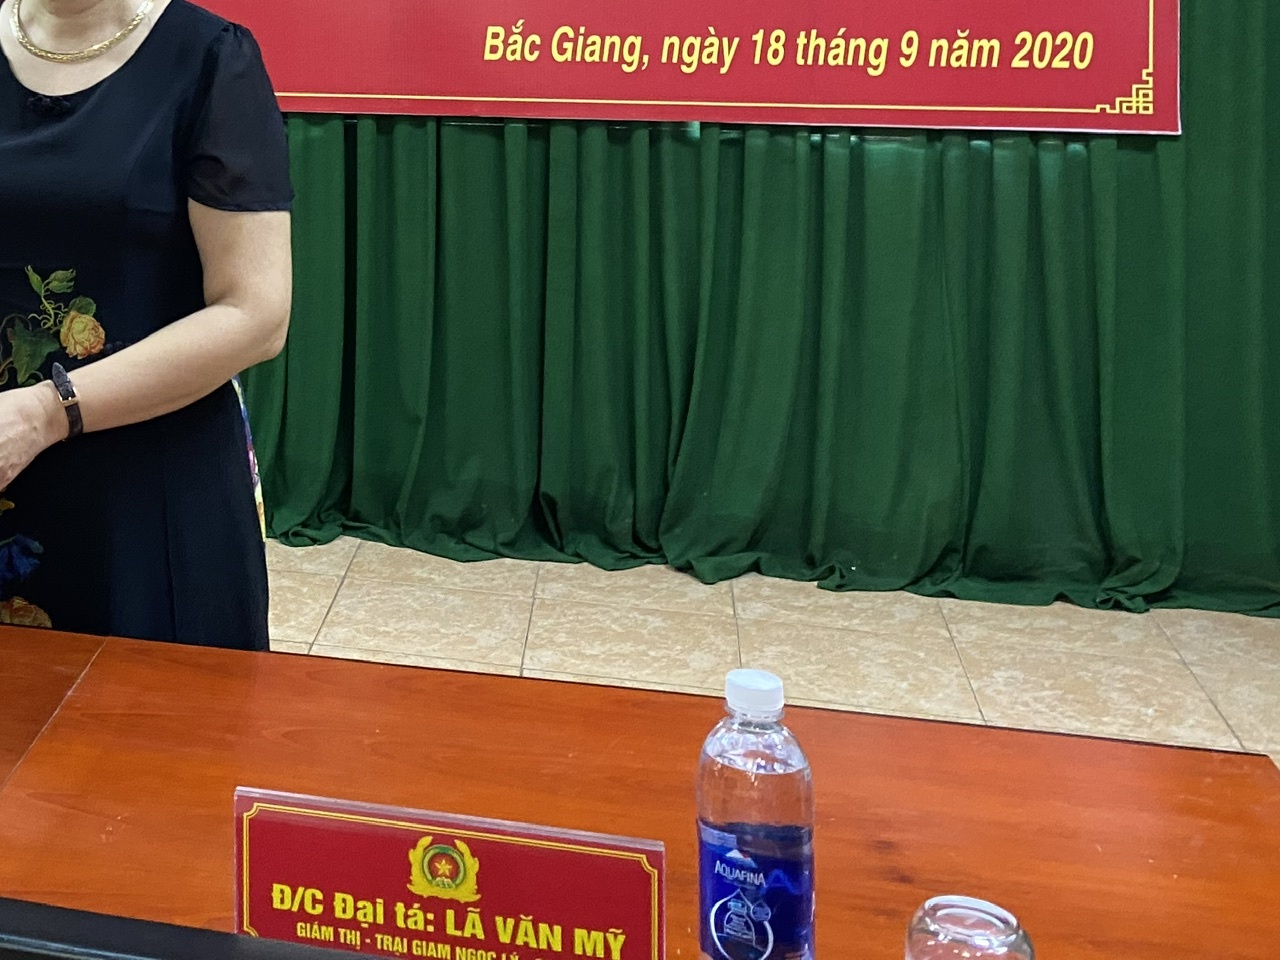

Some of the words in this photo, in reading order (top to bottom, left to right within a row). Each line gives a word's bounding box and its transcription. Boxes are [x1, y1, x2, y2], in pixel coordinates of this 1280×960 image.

[483, 18, 541, 62] Bắc
[551, 25, 650, 73] Giang,
[661, 26, 740, 75] ngày
[751, 28, 786, 66] 18
[796, 27, 889, 76] tháng
[898, 30, 918, 68] 9
[927, 28, 1001, 68] năm
[1010, 30, 1095, 70] 2020
[714, 860, 767, 888] AQUAFINA
[271, 883, 324, 916] Đ/C
[333, 892, 384, 928] Đại
[394, 901, 435, 932] tá:
[445, 906, 485, 940] LÃ
[494, 914, 563, 952] VĂN
[574, 928, 626, 960] MỸ
[296, 920, 335, 942] GIÁM
[337, 927, 361, 950] THỊ
[374, 933, 408, 956] TRẠI
[411, 939, 452, 960] GIAM
